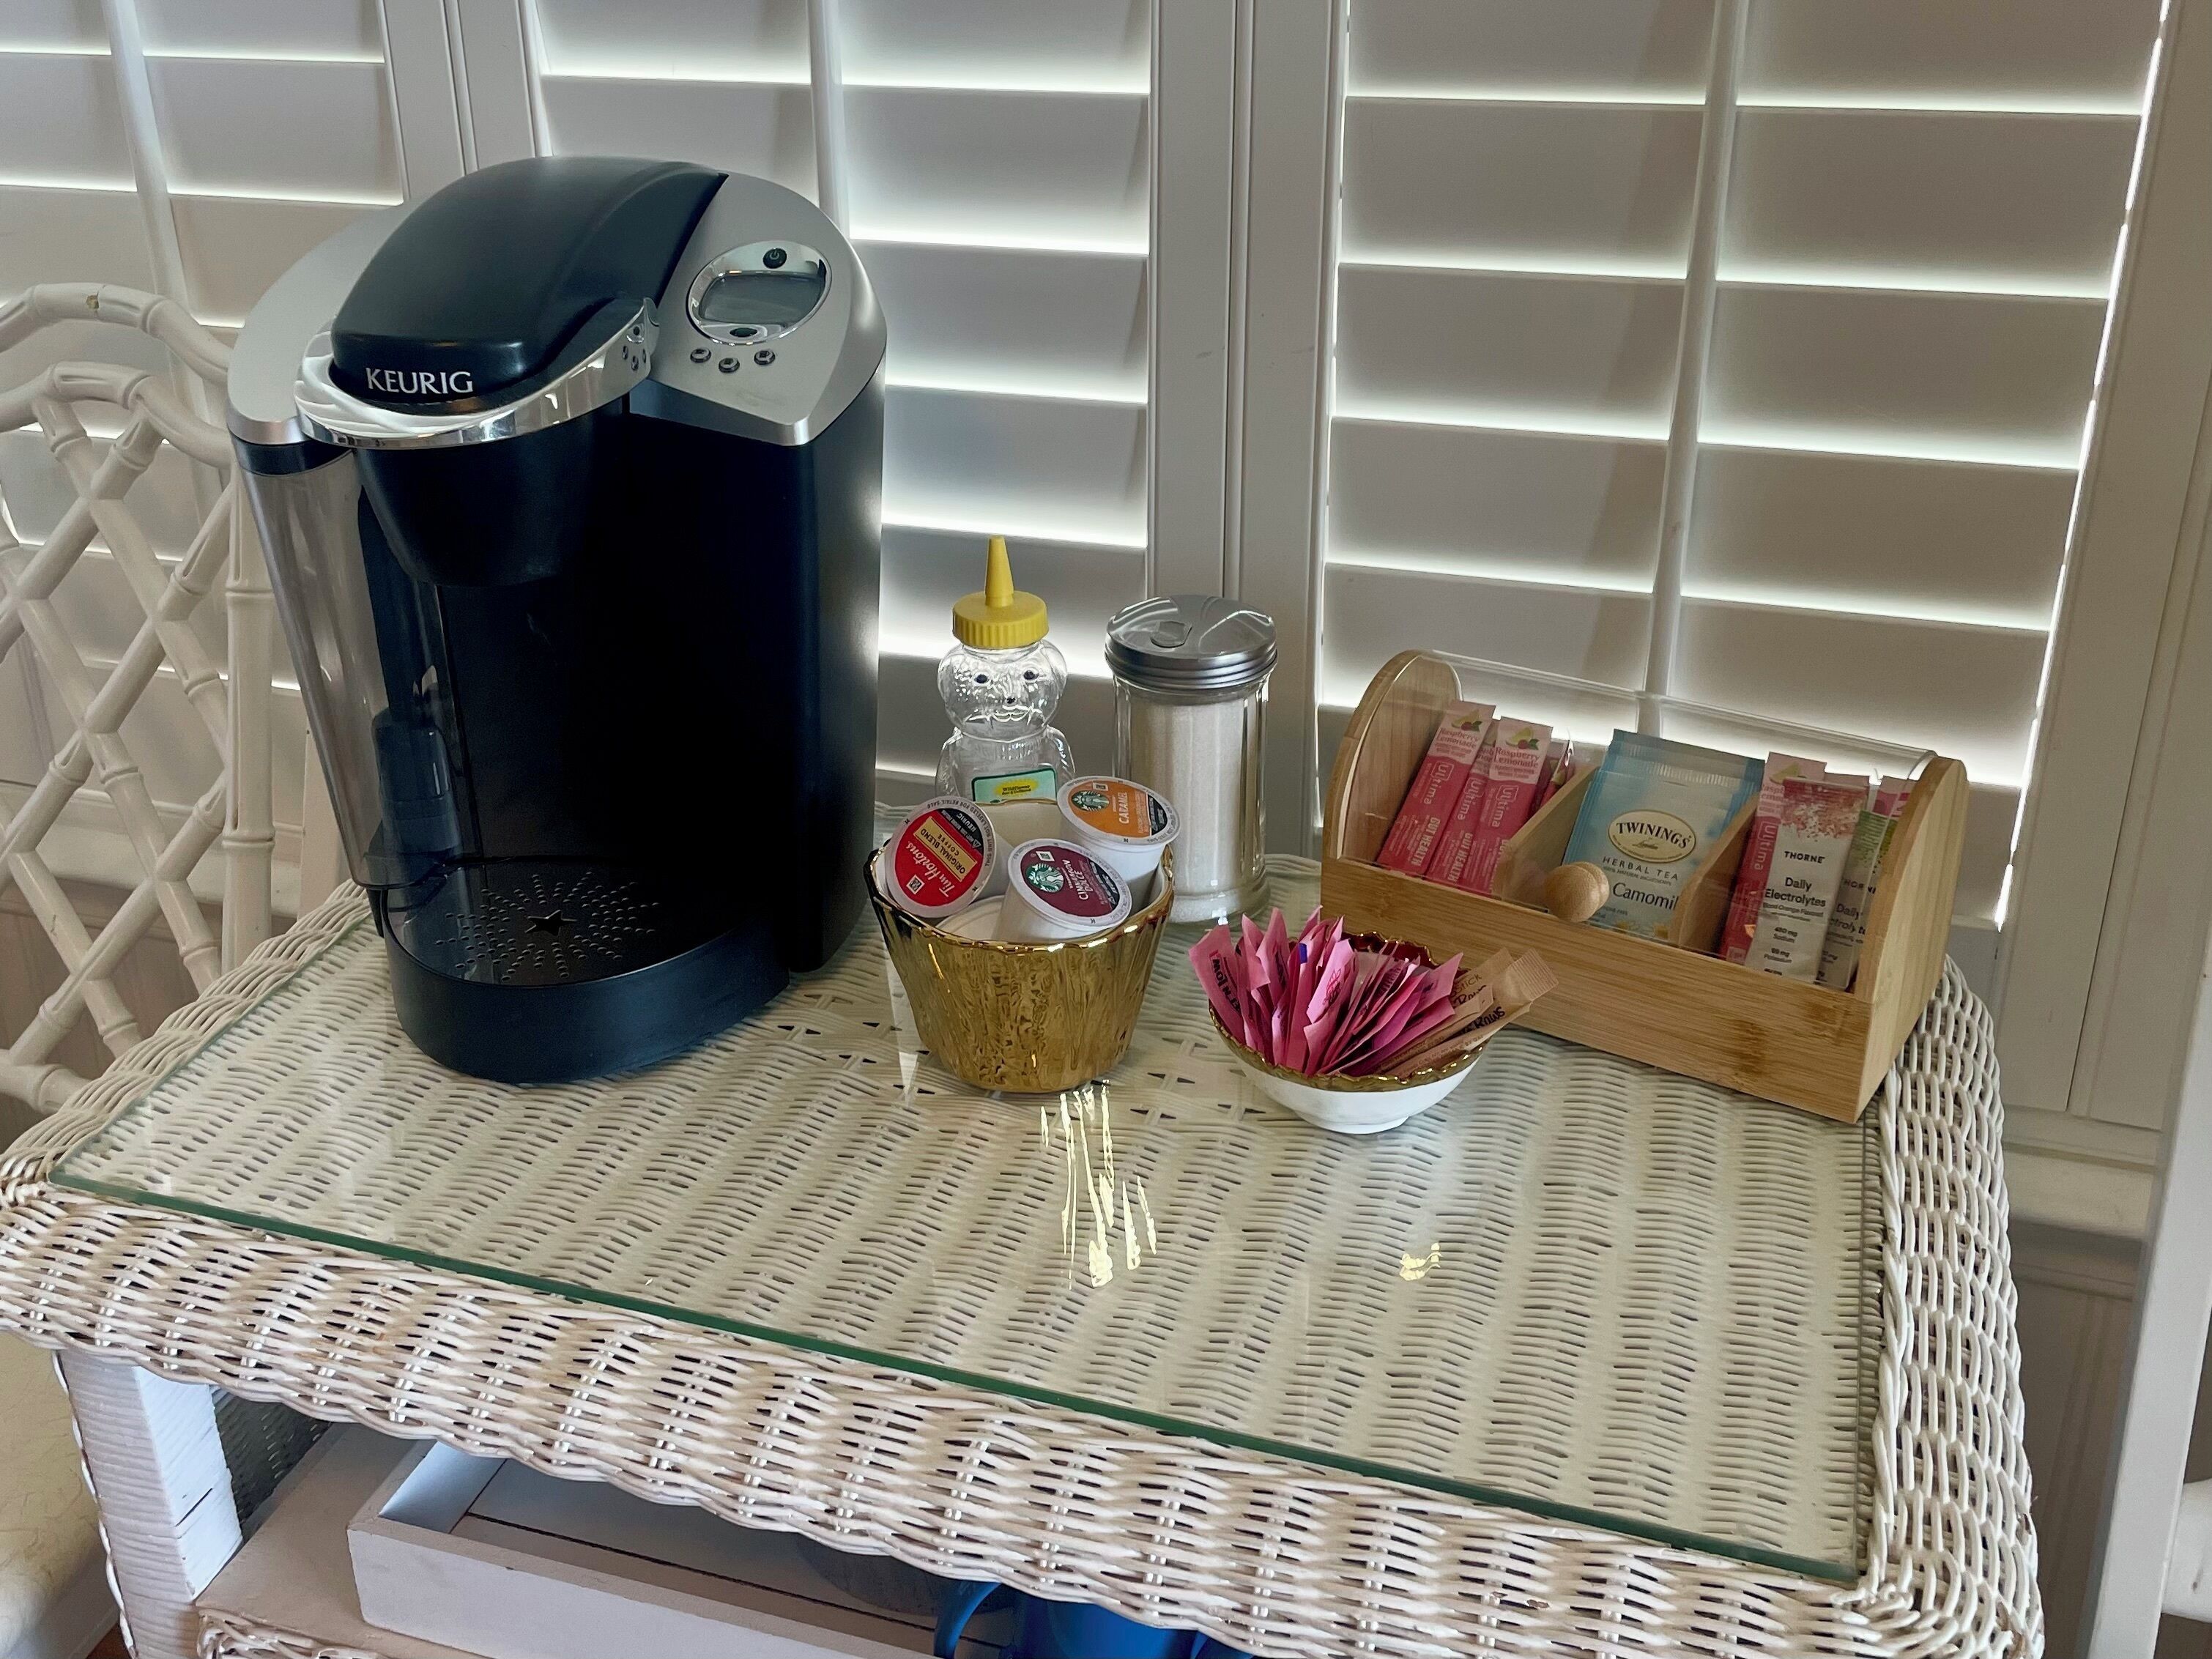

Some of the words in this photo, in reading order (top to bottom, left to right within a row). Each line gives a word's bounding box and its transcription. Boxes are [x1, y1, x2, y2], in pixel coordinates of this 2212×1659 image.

[365, 367, 473, 394] KEURIG
[1436, 732, 1477, 749] Lemonade
[1440, 727, 1479, 742] Raspberry
[1493, 754, 1538, 768] Lemonade
[1496, 746, 1539, 760] Raspberry
[1424, 762, 1450, 805] Ultima
[1117, 792, 1129, 824] CARAMEL
[1457, 779, 1482, 820] Ultima
[1492, 785, 1515, 828] Ultima
[1428, 817, 1441, 835] GUT
[1616, 821, 1690, 849] TWININGS
[920, 828, 940, 849] BLEND
[938, 834, 960, 856] COFFEE
[1411, 834, 1433, 866] HEALTH
[1754, 825, 1777, 871] Ultima
[905, 842, 941, 880] Hortons
[940, 847, 965, 874] ORIGINAL
[1602, 856, 1649, 875] HERBAL
[1657, 869, 1678, 880] TEA
[1784, 850, 1826, 864] THORNE
[939, 873, 955, 897] Tim
[1612, 881, 1680, 910] Camomil
[1785, 877, 1812, 892] Daily
[1764, 888, 1826, 908] Electrolytes
